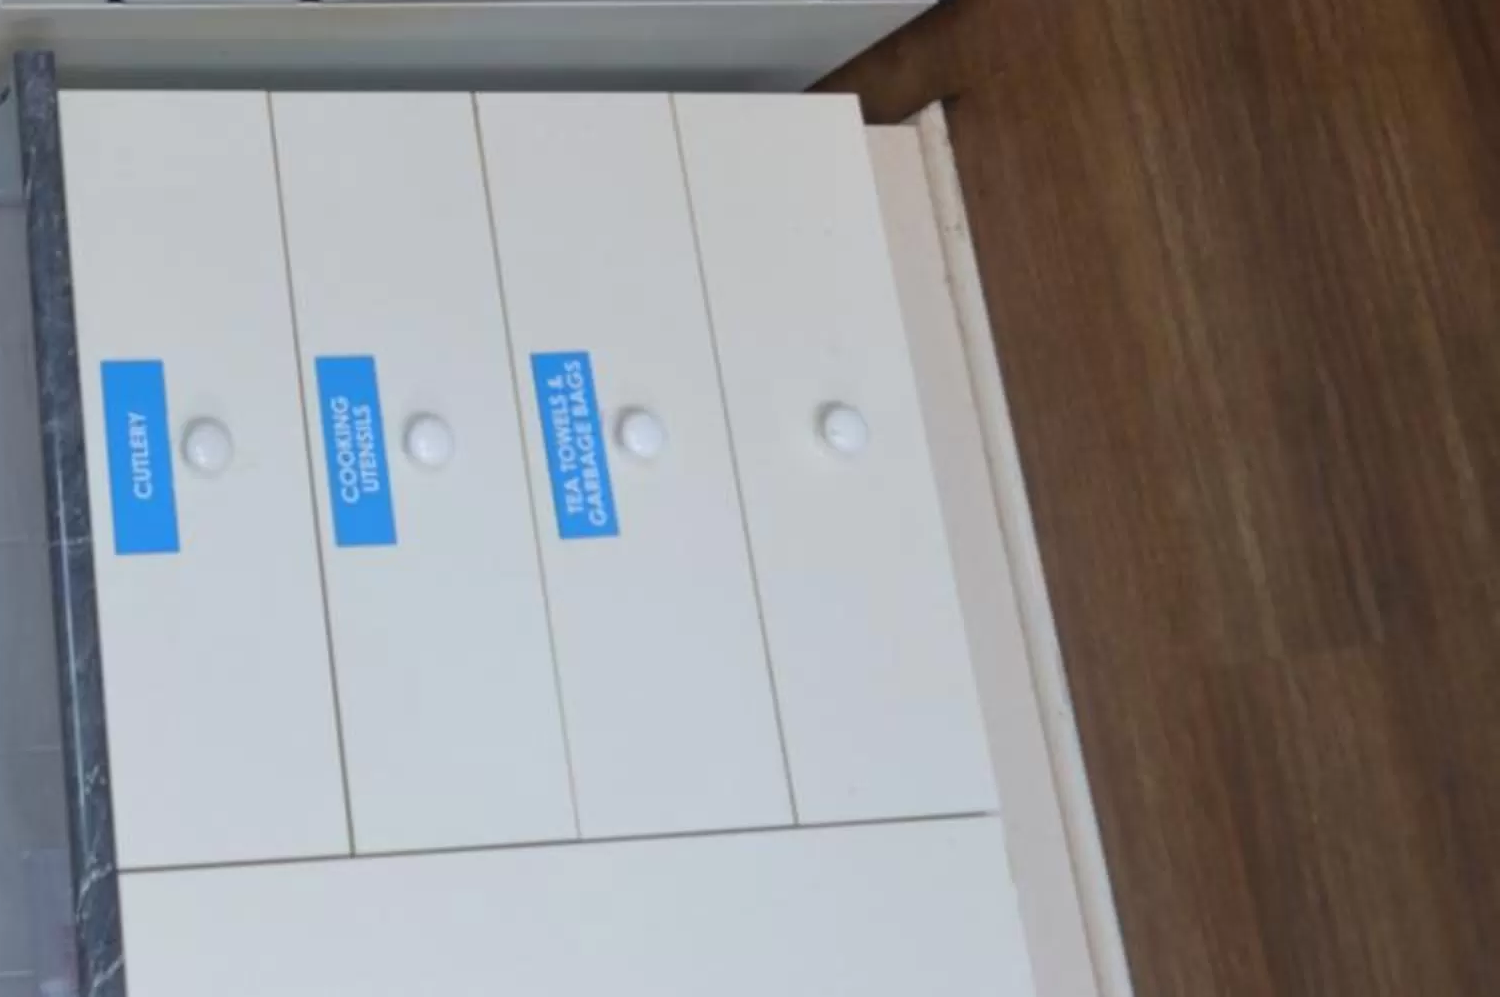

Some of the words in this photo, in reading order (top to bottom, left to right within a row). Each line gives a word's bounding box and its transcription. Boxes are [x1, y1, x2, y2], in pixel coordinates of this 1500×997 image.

[546, 375, 563, 389] &
[564, 360, 587, 417] BAGS
[126, 410, 153, 500] CUTLERY
[329, 395, 361, 504] COOKING
[352, 403, 380, 494] UTENSILS
[548, 395, 577, 473] TOWELS
[575, 422, 607, 527] GARBAGE
[564, 478, 584, 514] TEA
